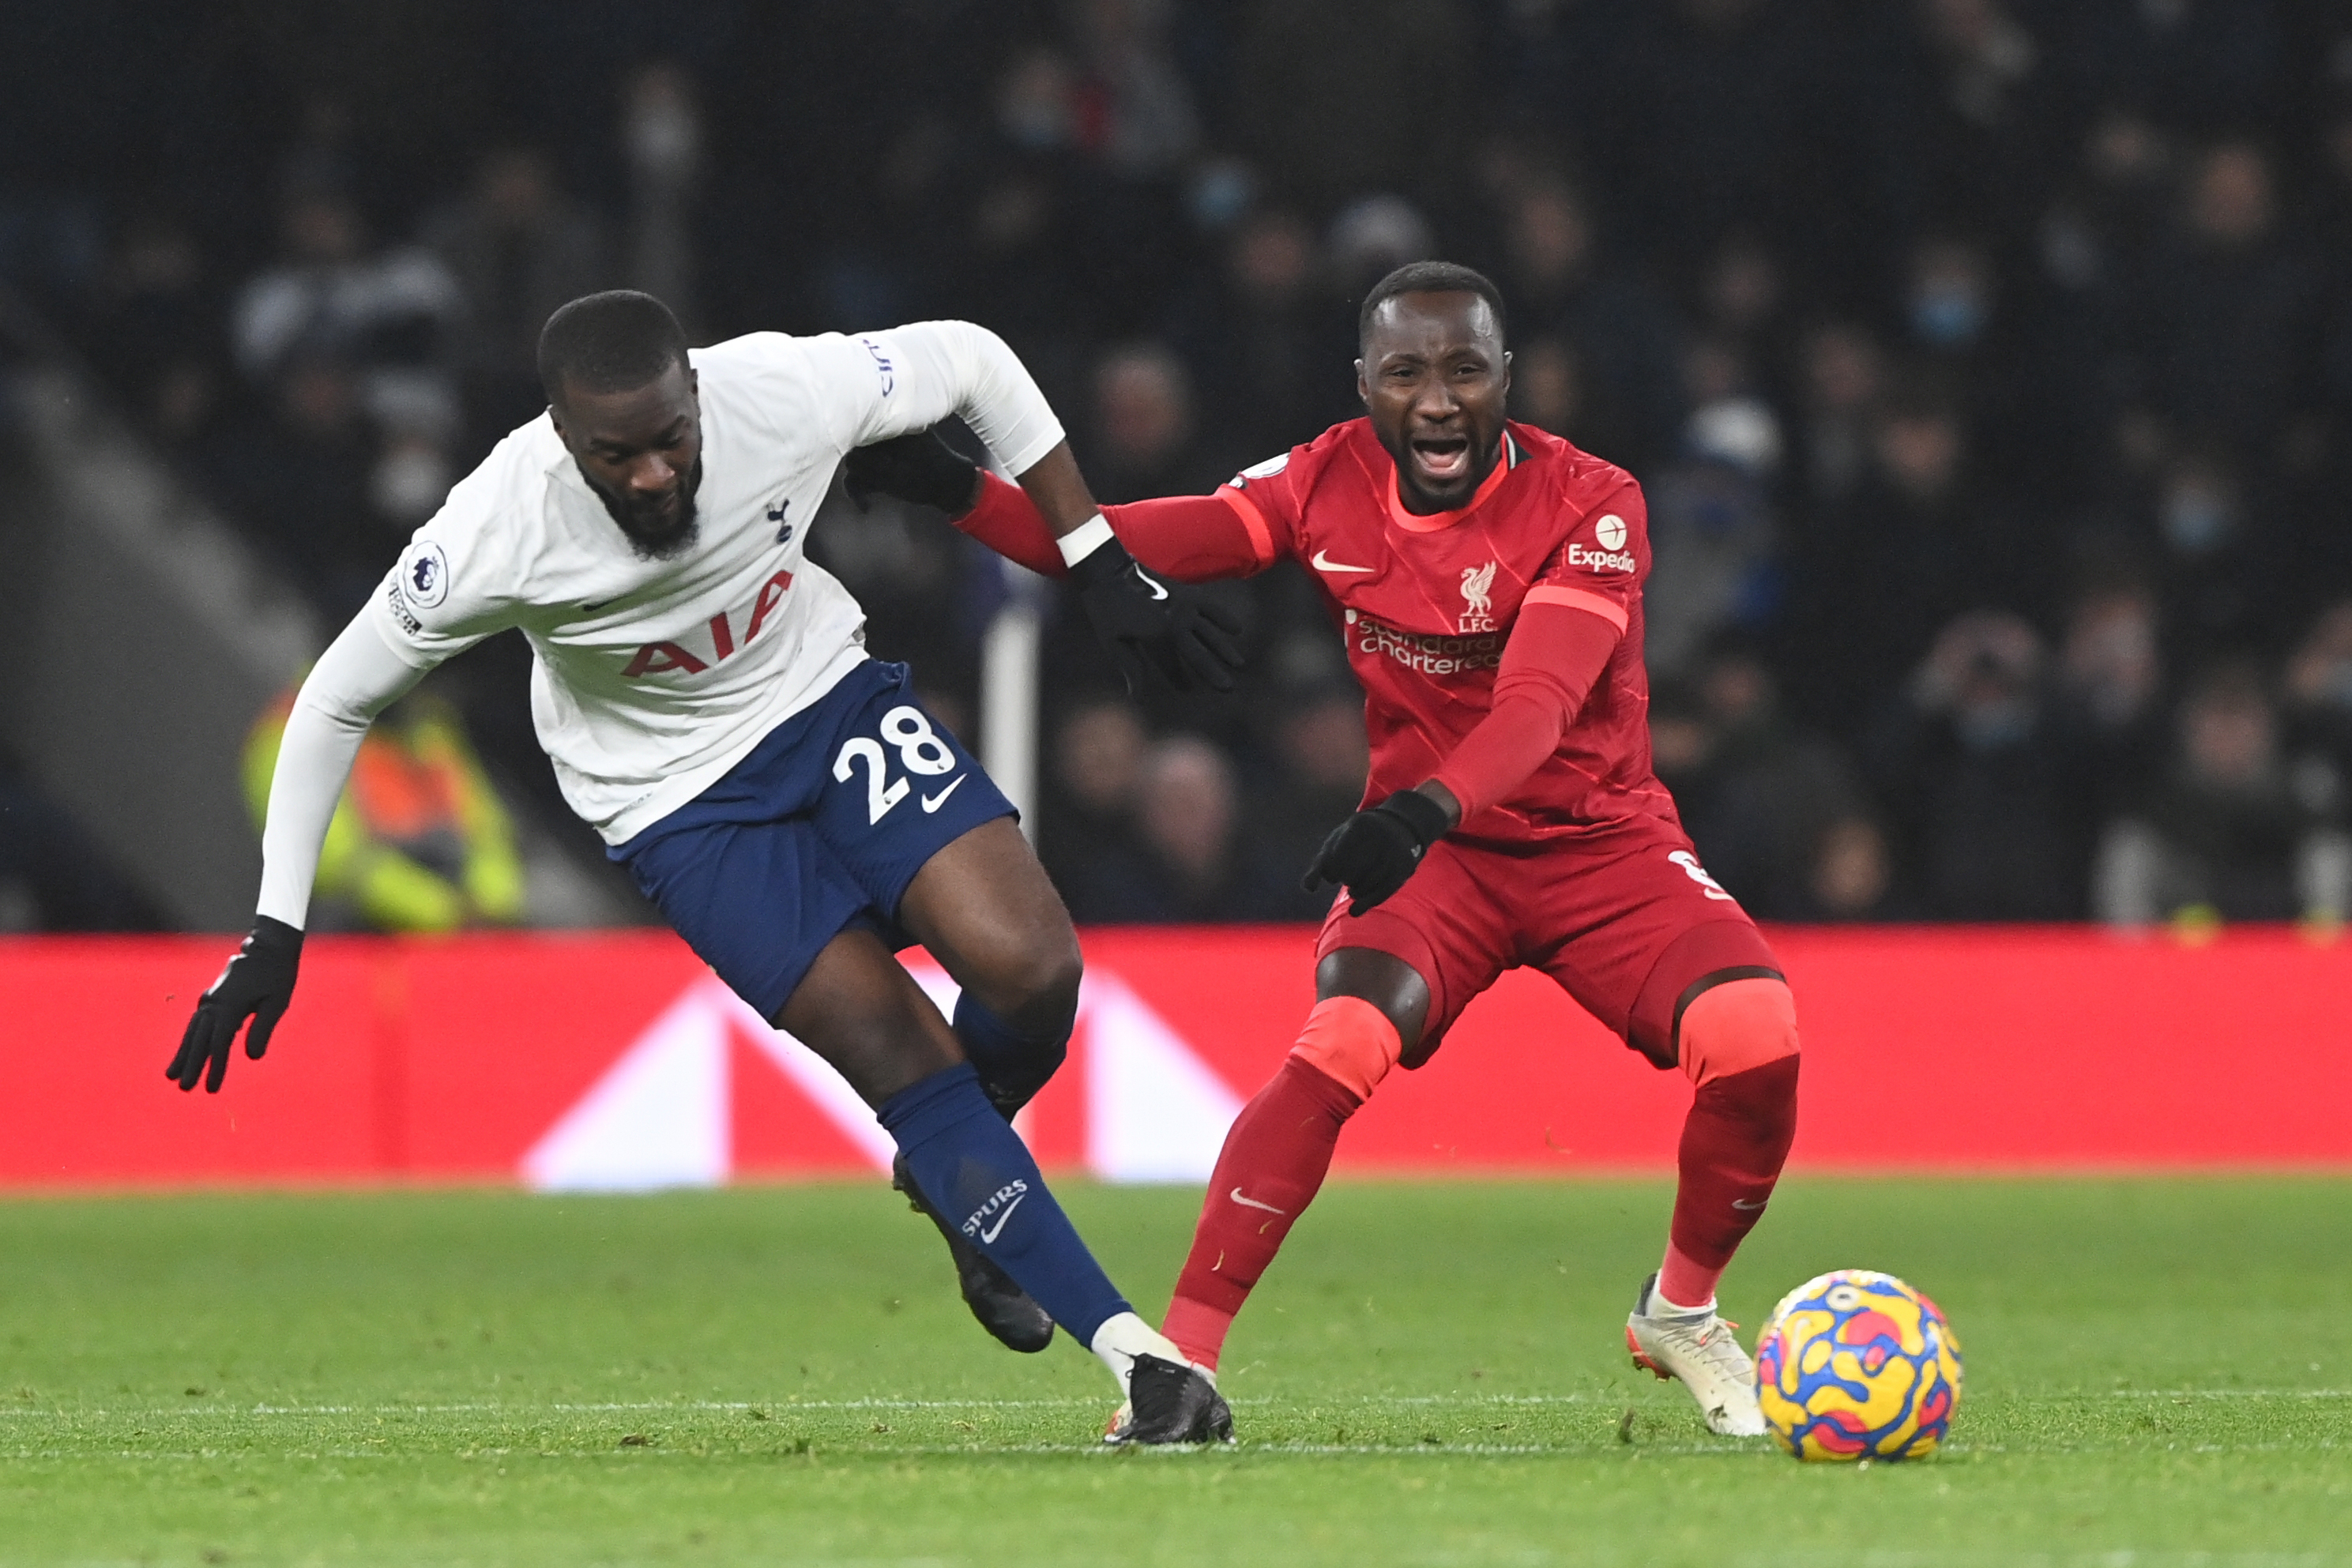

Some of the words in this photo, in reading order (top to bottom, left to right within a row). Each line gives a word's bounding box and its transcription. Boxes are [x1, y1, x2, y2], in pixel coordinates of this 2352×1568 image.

[1567, 543, 1635, 573] Expedia
[620, 569, 794, 678] AIA
[832, 705, 956, 826] 28
[962, 1179, 1028, 1237] SPURS
